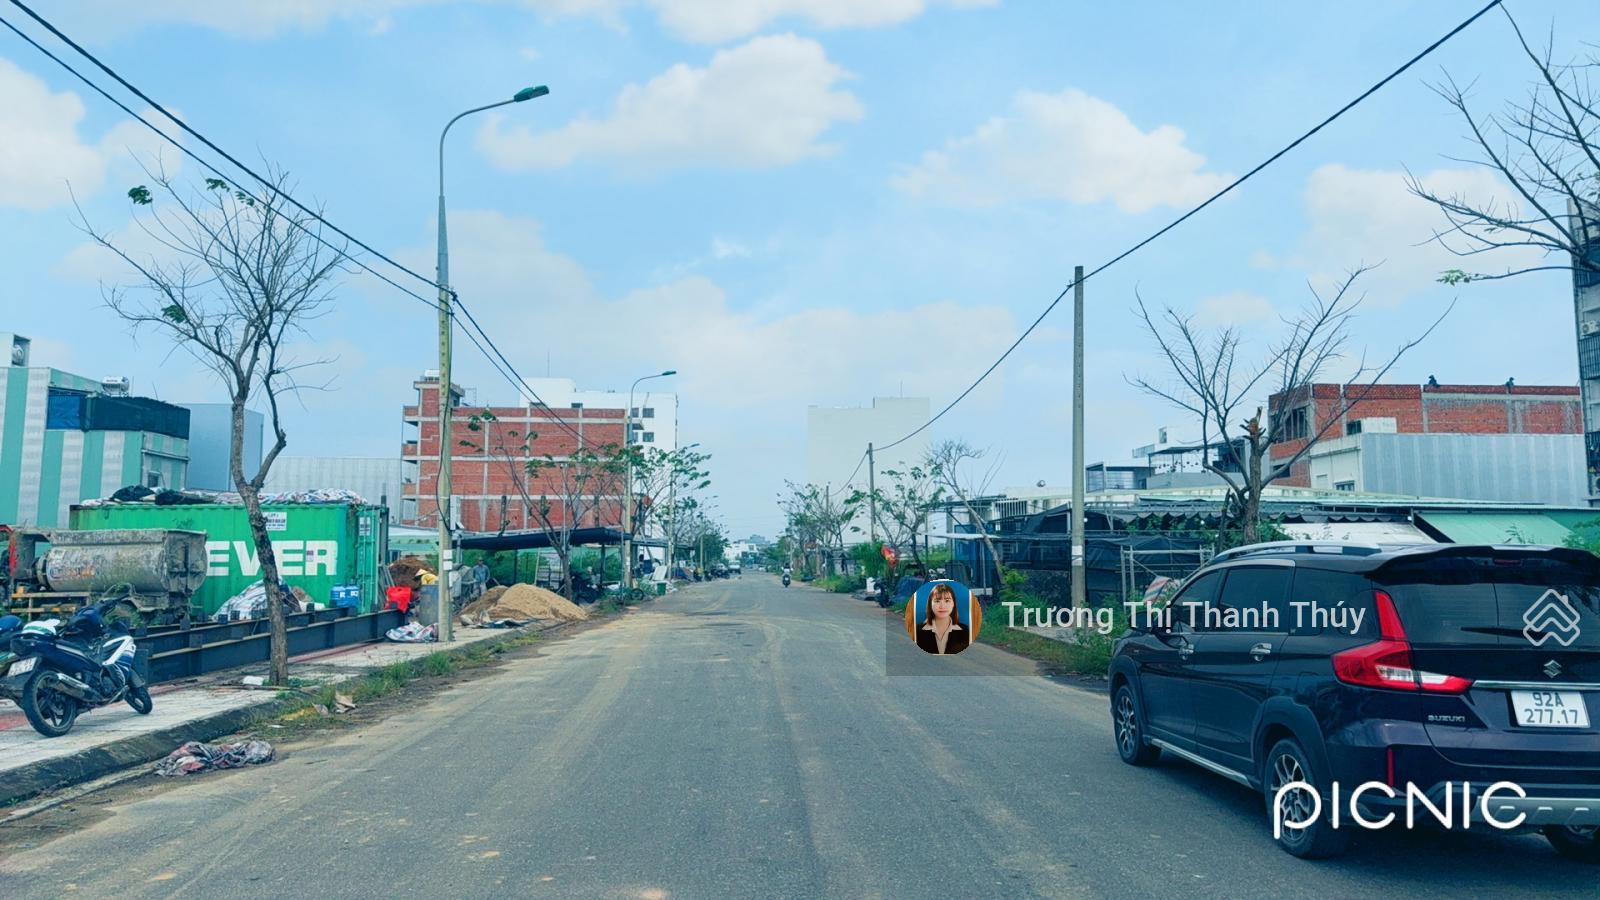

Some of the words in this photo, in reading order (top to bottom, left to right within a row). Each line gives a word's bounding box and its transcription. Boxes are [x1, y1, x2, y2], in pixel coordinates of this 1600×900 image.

[204, 540, 338, 576] EVER
[1532, 691, 1564, 707] 92A
[1427, 714, 1466, 722] SUZUKI
[1524, 708, 1579, 724] 277.17
